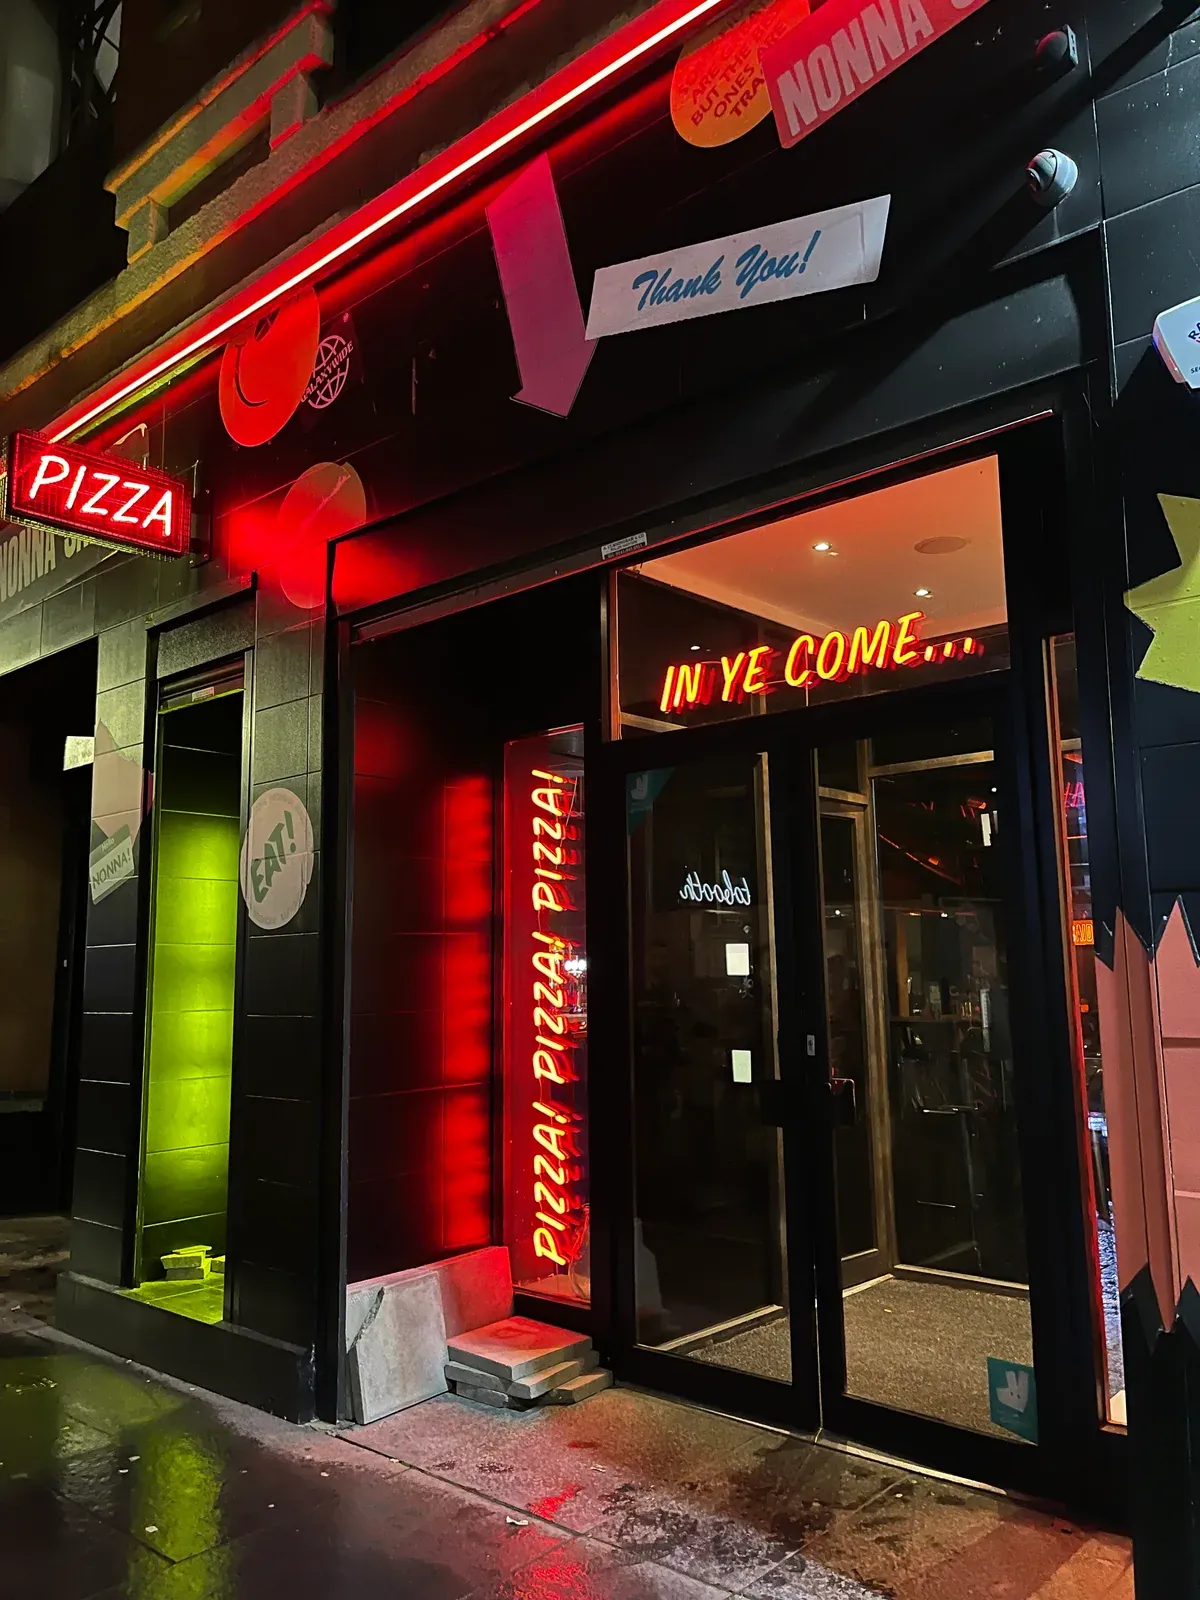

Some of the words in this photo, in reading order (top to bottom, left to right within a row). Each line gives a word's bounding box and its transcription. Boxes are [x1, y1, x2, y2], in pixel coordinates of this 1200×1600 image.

[690, 85, 720, 127] BUT
[719, 45, 752, 84] THE
[691, 66, 721, 105] ARE
[713, 64, 755, 119] ONES
[729, 69, 765, 118] TRA
[776, 0, 934, 137] NONNA
[631, 254, 725, 312] Thank
[734, 229, 822, 300] You!
[28, 454, 174, 537] PIZZA
[659, 662, 702, 712] IN
[720, 645, 773, 703] YE
[784, 610, 974, 688] COME...
[92, 847, 131, 890] NONNA!
[251, 810, 297, 904] EAT!
[531, 769, 564, 912] PIZZA!
[531, 931, 566, 1085] PIZZA!
[532, 1101, 568, 1266] PIZZA!
